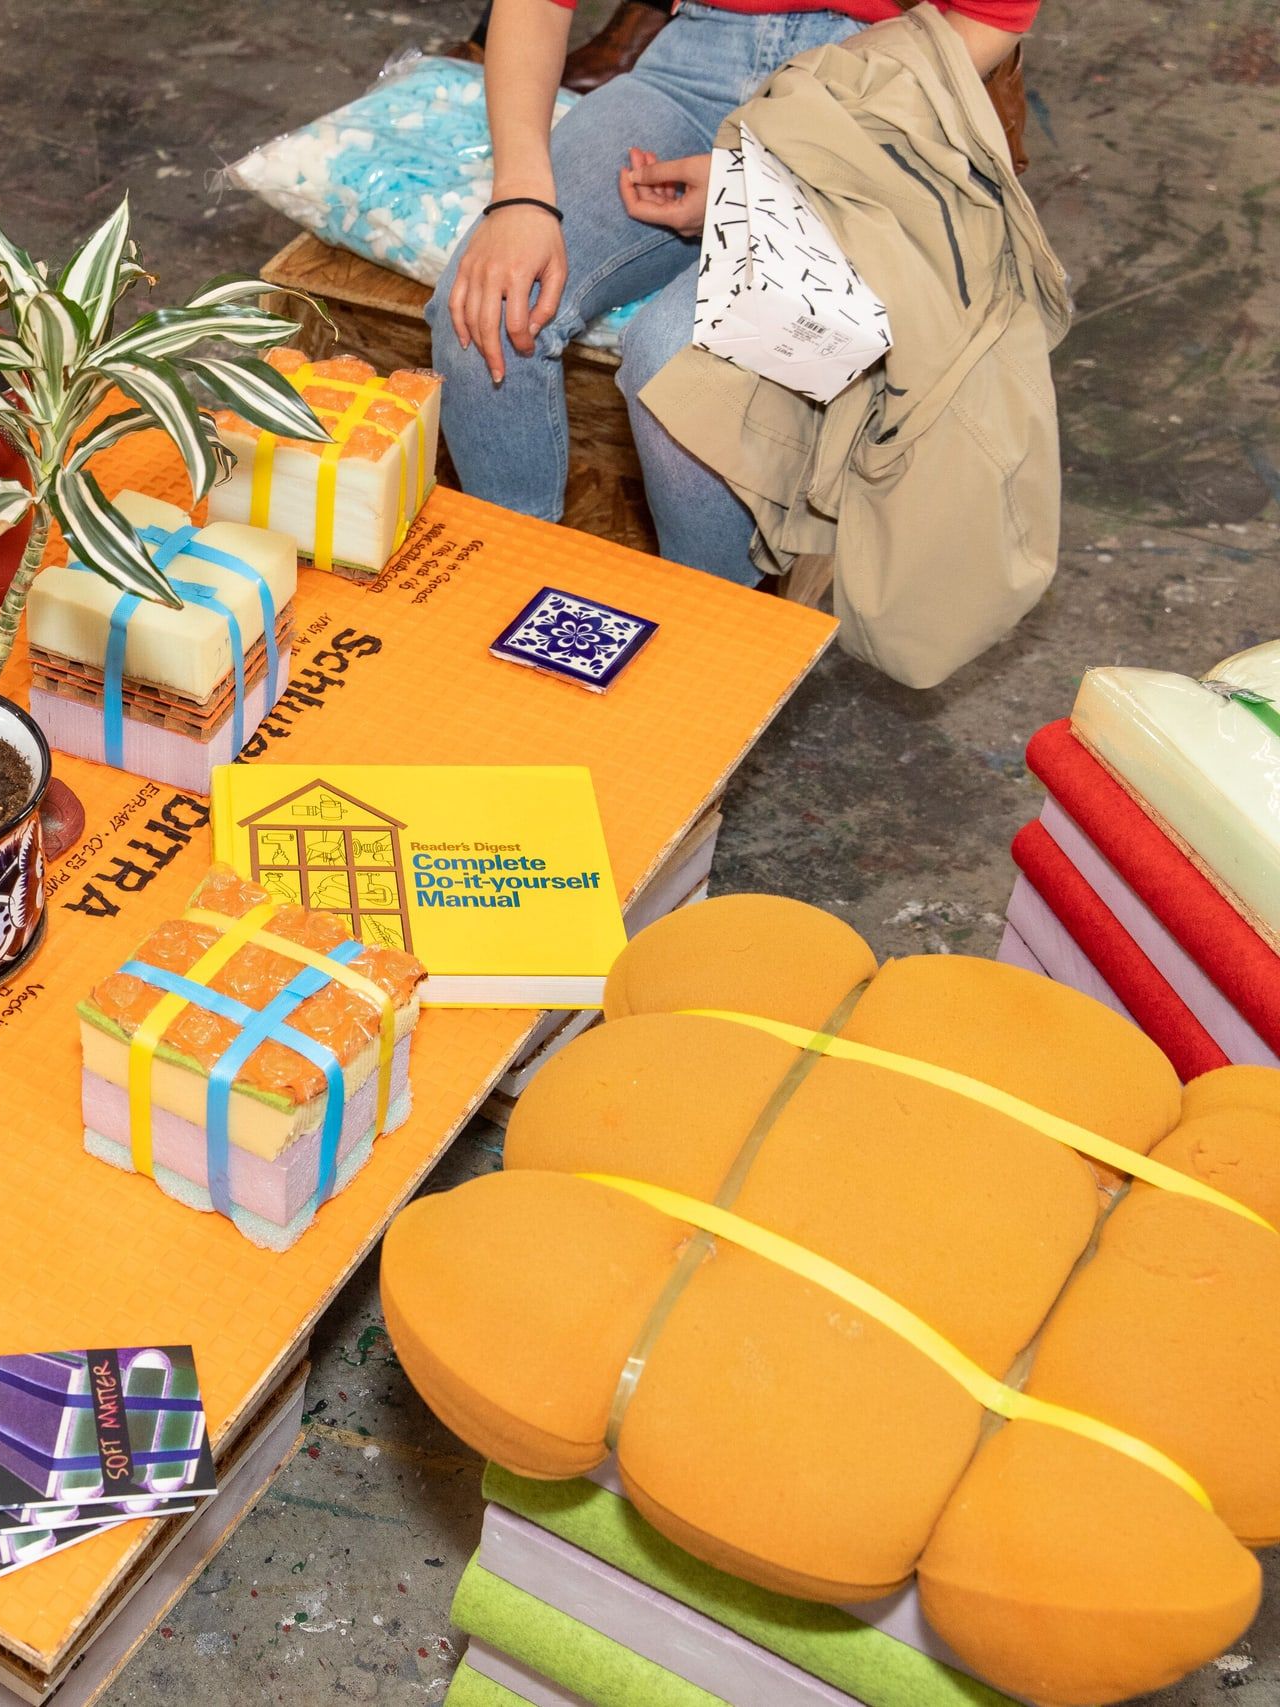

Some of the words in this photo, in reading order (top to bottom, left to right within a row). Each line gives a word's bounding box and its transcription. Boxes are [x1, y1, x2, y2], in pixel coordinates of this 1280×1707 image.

[410, 842, 470, 852] Reader's
[474, 842, 521, 855] Digest
[412, 853, 546, 874] Complete
[414, 872, 600, 891] Do-it-yourself
[416, 890, 521, 908] Manual
[93, 1359, 120, 1430] MATTER
[100, 1437, 129, 1481] SOFT
